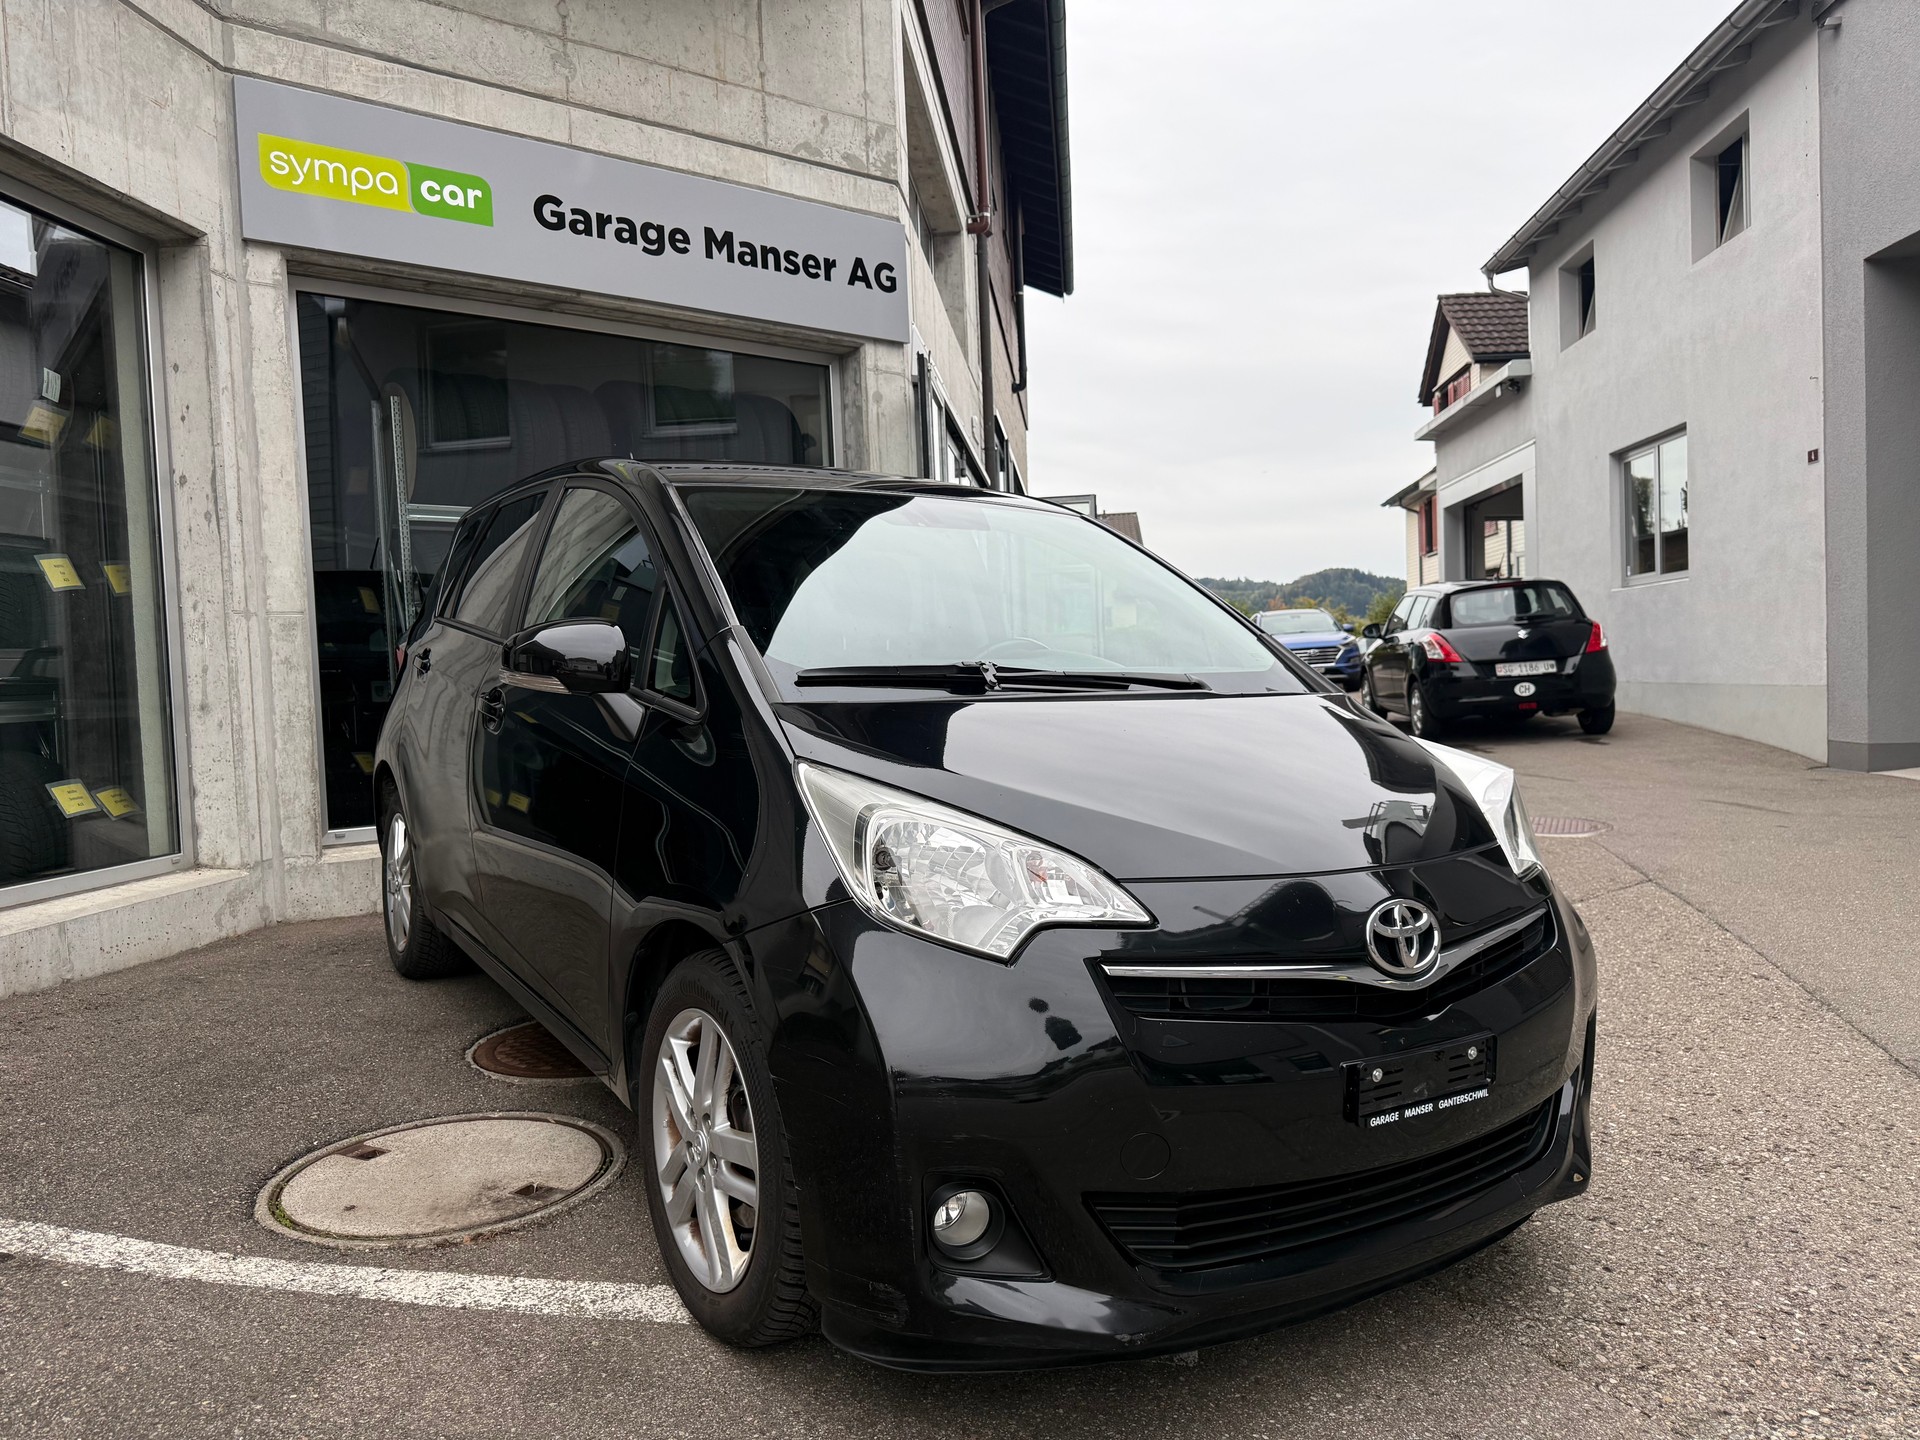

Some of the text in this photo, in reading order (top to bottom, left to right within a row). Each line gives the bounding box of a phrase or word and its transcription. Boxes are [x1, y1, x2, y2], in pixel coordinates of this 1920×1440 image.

[269, 150, 483, 209] sympa car
[533, 194, 897, 294] Garage Manser AG
[1502, 664, 1514, 674] SG
[1518, 684, 1531, 694] CH
[1370, 1088, 1489, 1127] GARAGE MANSER GANTERSCHWIL
